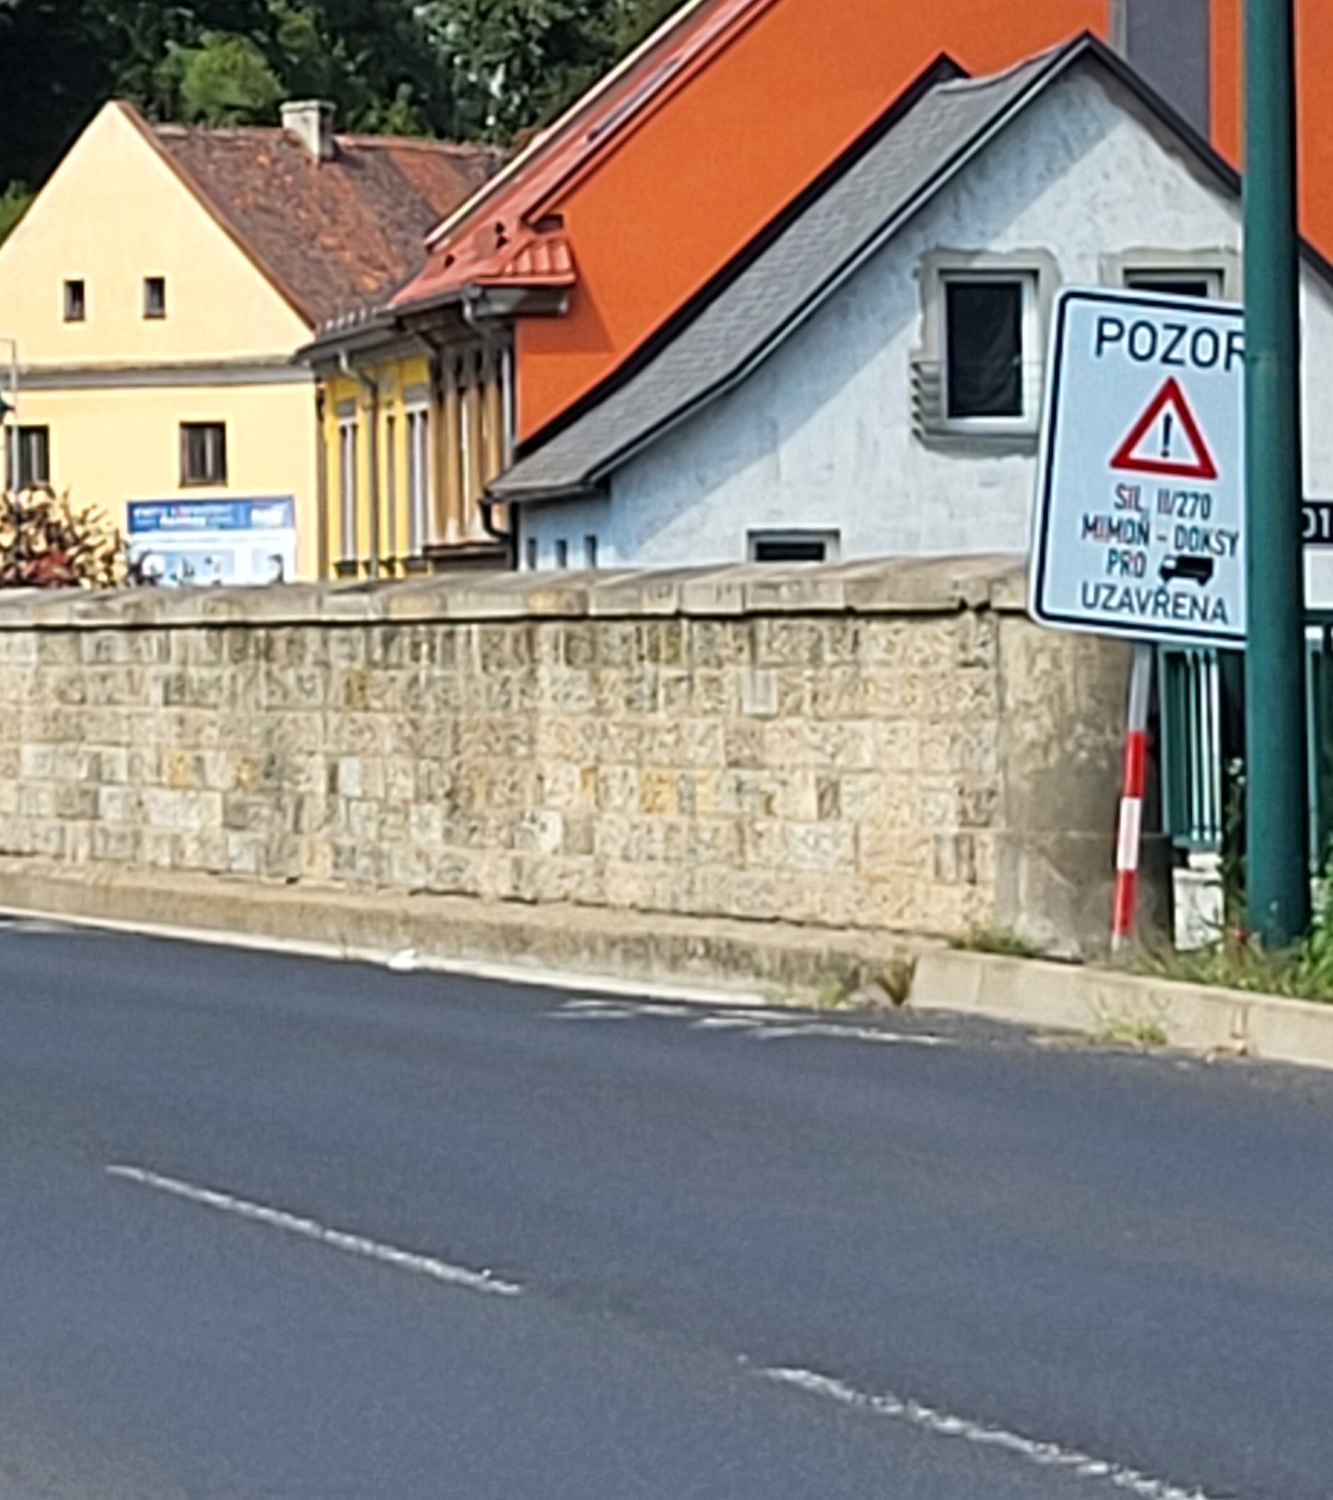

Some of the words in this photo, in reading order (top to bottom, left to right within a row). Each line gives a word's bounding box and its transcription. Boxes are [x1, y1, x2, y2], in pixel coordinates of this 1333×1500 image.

[1175, 525, 1239, 557] DOKSY
[1106, 547, 1147, 578] PRO
[1082, 581, 1229, 626] UZAVŘENA
